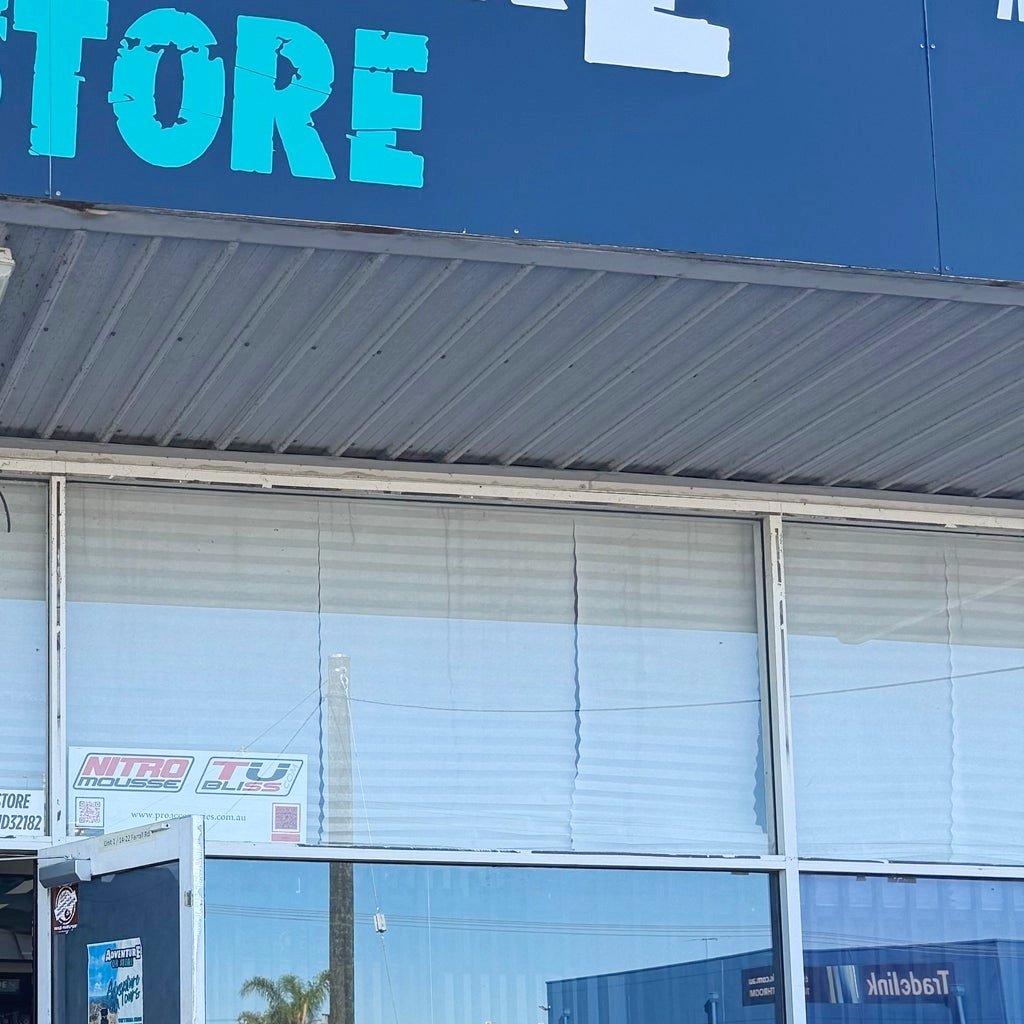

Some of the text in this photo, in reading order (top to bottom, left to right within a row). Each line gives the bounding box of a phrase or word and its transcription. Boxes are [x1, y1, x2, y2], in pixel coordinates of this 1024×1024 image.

[81, 756, 190, 779] NITRO
[77, 776, 182, 790] MOUSSE
[202, 780, 282, 792] BLISS
[104, 945, 142, 961] ADVENTURE
